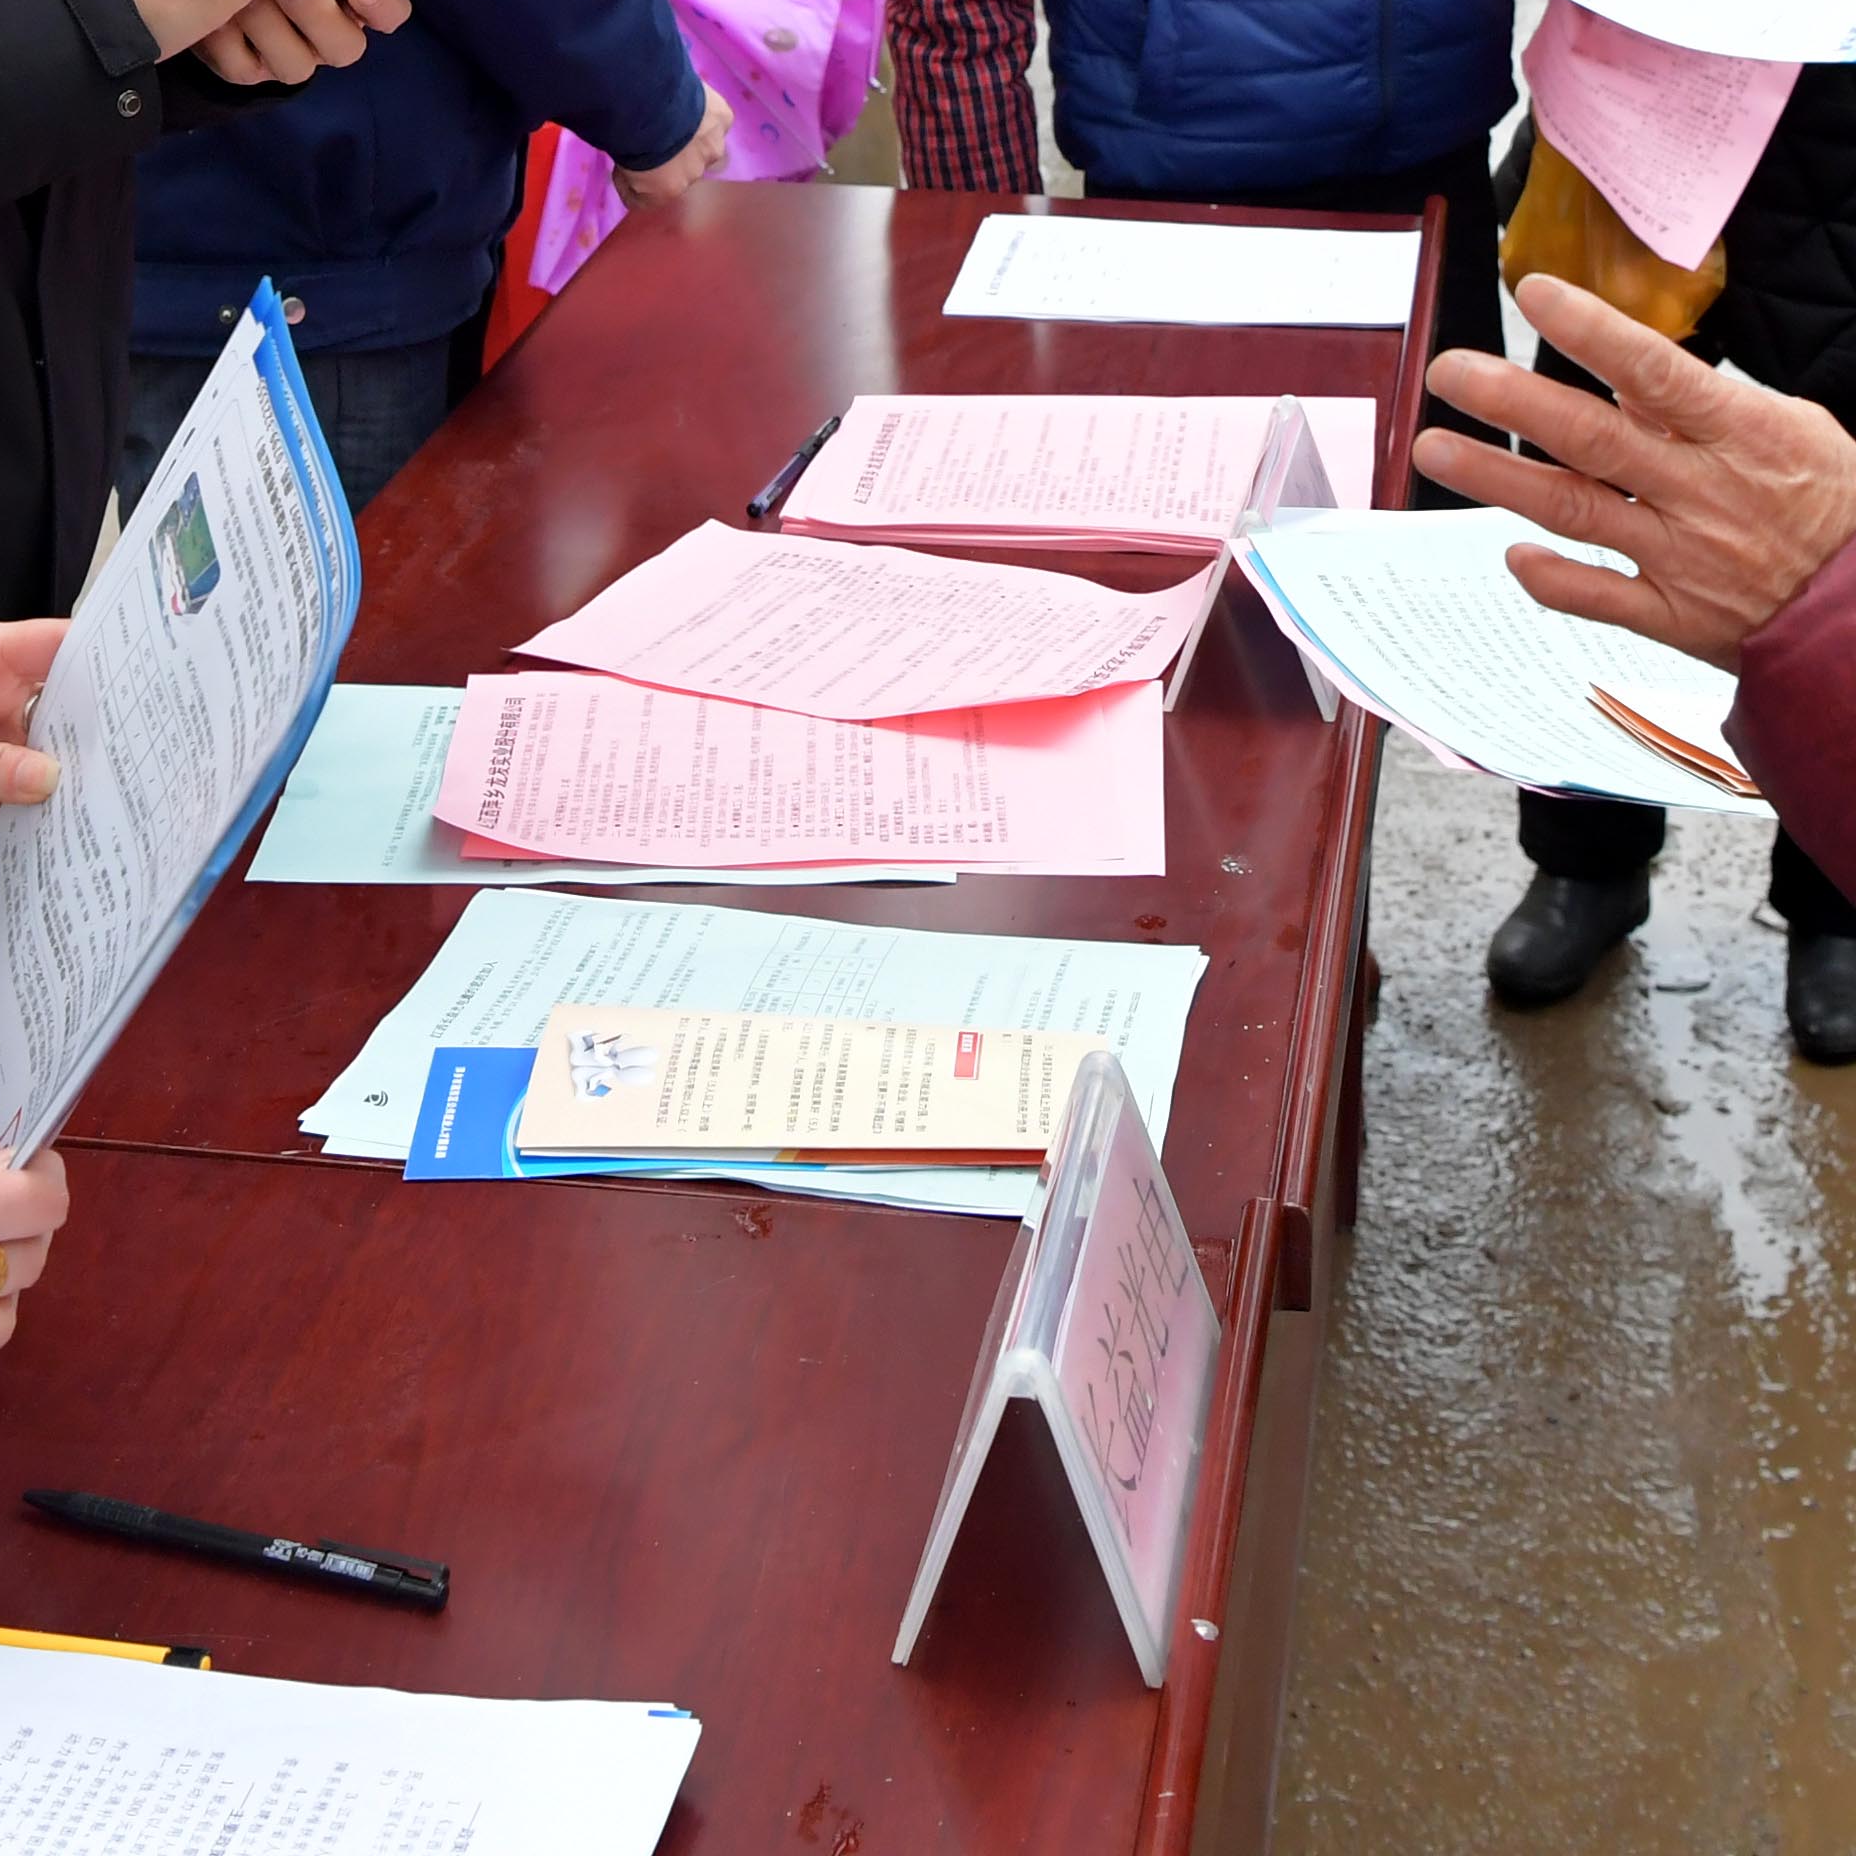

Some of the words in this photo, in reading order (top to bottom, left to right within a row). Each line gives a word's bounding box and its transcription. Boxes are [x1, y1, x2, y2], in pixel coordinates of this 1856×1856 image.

[476, 697, 526, 830] 江西萍乡龙发实业股份有限公司
[1074, 1174, 1190, 1550] 长益光电
